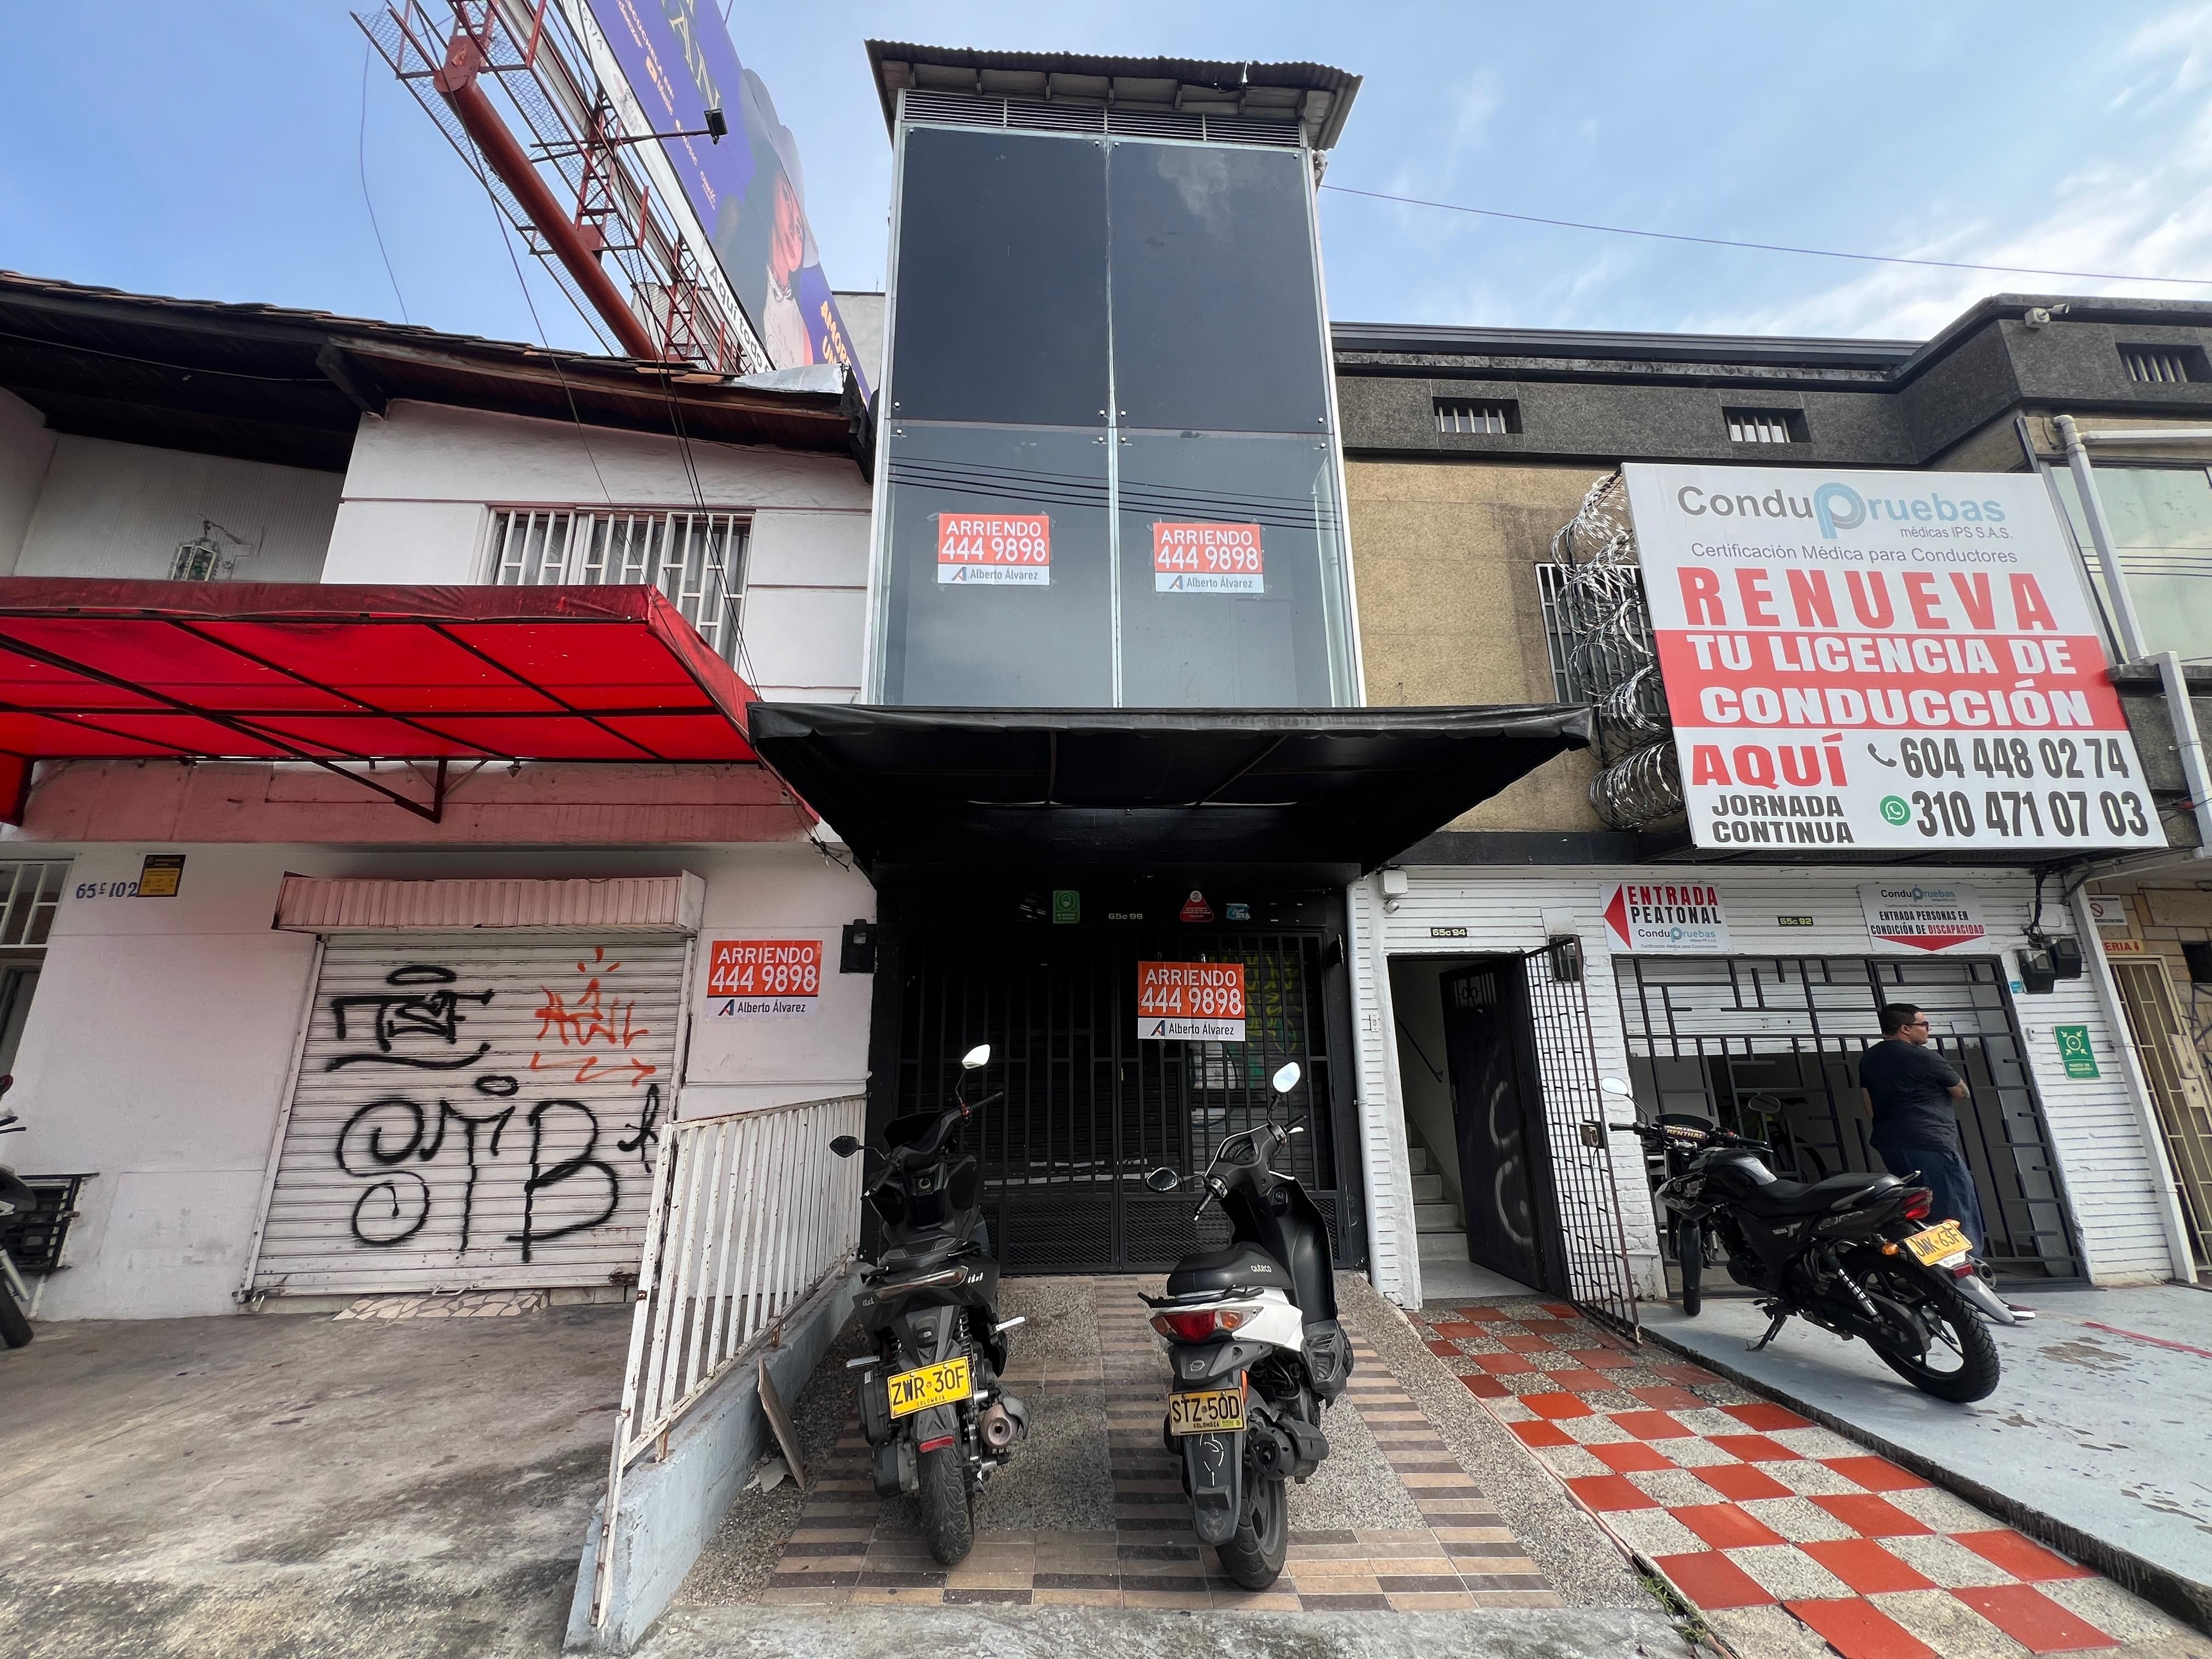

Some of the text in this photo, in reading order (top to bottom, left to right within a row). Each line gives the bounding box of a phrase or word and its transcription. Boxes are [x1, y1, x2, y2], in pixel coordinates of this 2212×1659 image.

[709, 267, 738, 320] Aquí
[946, 520, 1041, 537] ARRIENDO
[1161, 529, 1253, 546] ARRIENDO
[1900, 526, 2013, 539] médicas IPS S.A.S.
[941, 537, 1046, 562] 444 9898
[1158, 545, 1259, 571] 444 9898
[1691, 543, 2018, 563] Certificación Médica para Conductores
[970, 569, 1002, 580] Alberto
[1006, 568, 1038, 580] Álvarez
[1187, 578, 1217, 588] Alberto
[1221, 576, 1252, 588] Álvarez
[1676, 566, 2059, 631] RENUEVA
[1686, 635, 2077, 675] TU LICENCIA DE
[1699, 679, 2095, 727] CONDUCCIÓN
[1691, 732, 1848, 791] AQUÍ
[1900, 737, 2130, 780] 604 448 02 74
[1711, 794, 1844, 818] JORNADA
[1912, 790, 2149, 838] 310 471 07 03
[1712, 820, 1855, 844] CONTINUA
[109, 882, 137, 898] 102
[1627, 885, 1719, 906] ENTRADA
[1630, 906, 1722, 924] PEATONAL
[1879, 911, 1969, 921] ENTRADA PERSONAS EN
[1870, 922, 1984, 935] CONDICIÓN DE DISCAPACIDAD
[717, 947, 814, 964] ARRIENDO
[2103, 942, 2132, 951] ERIA
[711, 965, 817, 992] 444 9898
[1145, 968, 1237, 987] ARRIENDO
[737, 1002, 770, 1013] Alberto
[772, 999, 806, 1013] Álvarez
[1141, 987, 1242, 1015] 444 9898
[1169, 1022, 1199, 1034] Alberto
[1203, 1021, 1234, 1035] Álvarez
[1666, 1129, 1703, 1139] RENTHAL
[1909, 1226, 1960, 1257] JMK 63F
[1251, 1263, 1272, 1273] auteco
[891, 1365, 965, 1407] ZWR 30F
[916, 1395, 945, 1407] COLOMBIA
[1171, 1395, 1240, 1424] STZ 50D
